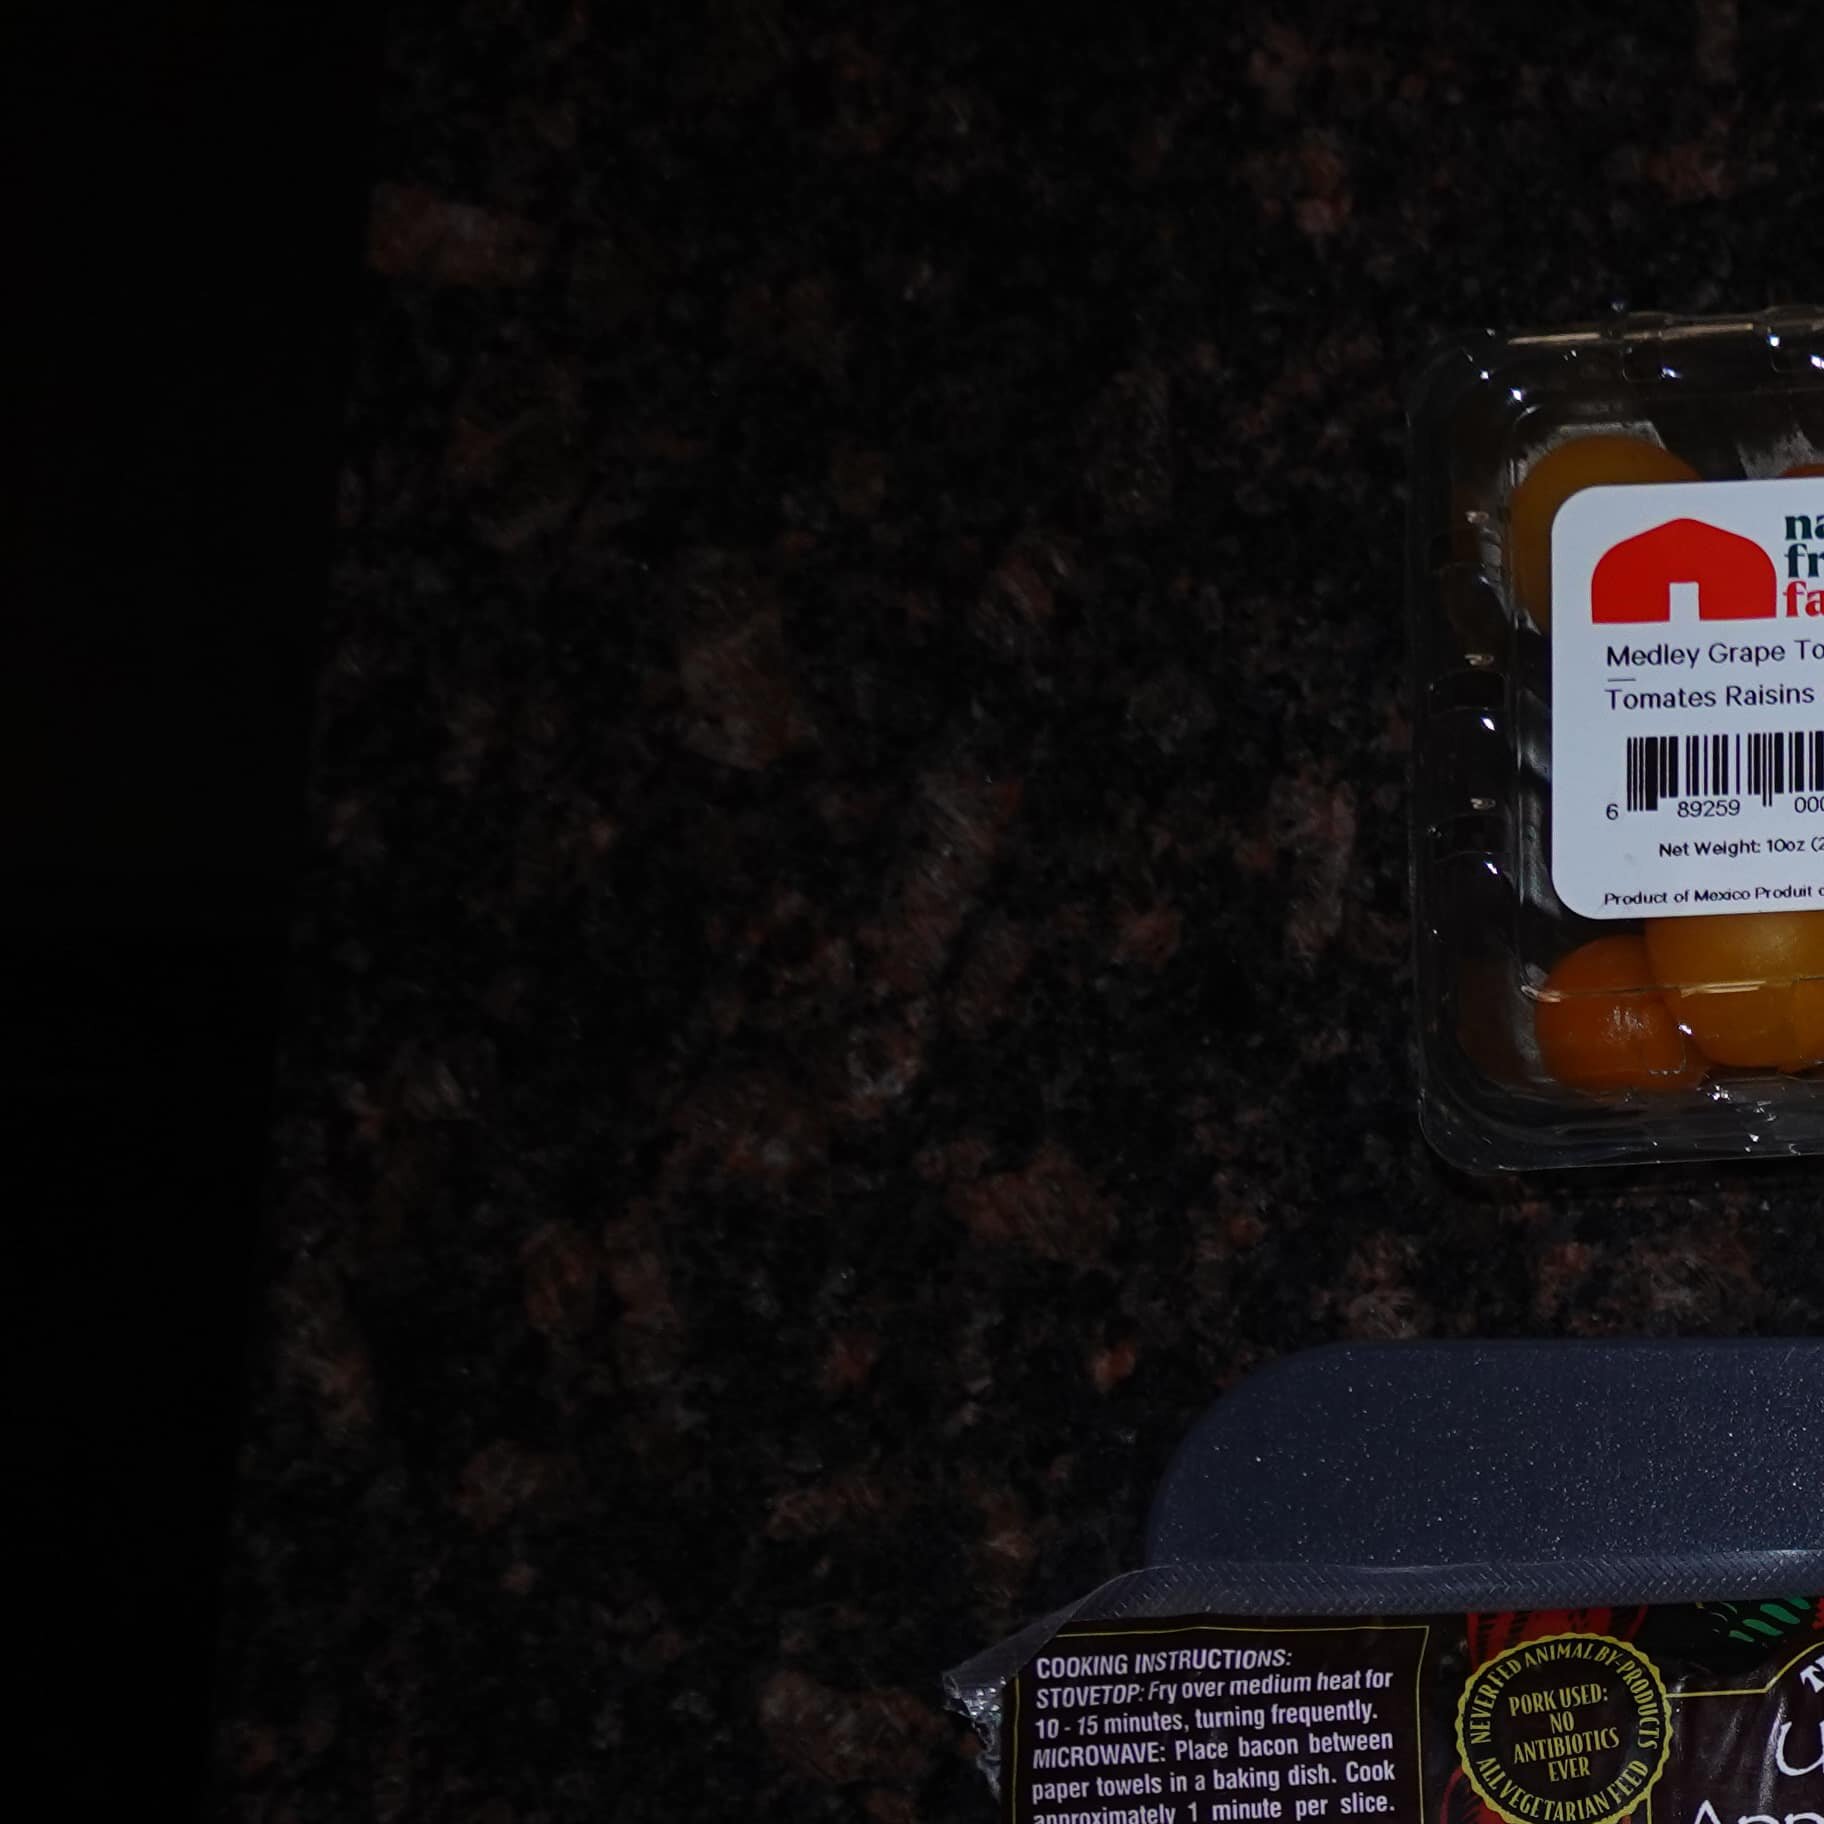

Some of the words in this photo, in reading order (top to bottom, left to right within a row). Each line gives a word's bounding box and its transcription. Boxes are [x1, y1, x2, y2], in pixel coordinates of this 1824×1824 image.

[1607, 644, 1700, 668] Medley
[1709, 642, 1785, 666] Grape
[1605, 687, 1716, 710] Tomates
[1726, 684, 1814, 706] Raisins
[1606, 803, 1619, 820] 6
[1677, 799, 1741, 817] 89259
[1659, 841, 1689, 857] Net
[1695, 839, 1761, 857] Weight:
[1767, 838, 1804, 853] 10oz
[1604, 891, 1667, 905] Product
[1674, 891, 1689, 903] of
[1695, 889, 1750, 902] Mexico
[1755, 885, 1812, 900] Produit
[1036, 1655, 1128, 1680] COOKING
[1135, 1649, 1292, 1674] INSTRUCTIONS:
[1036, 1683, 1144, 1709] STOVETOP:
[1148, 1681, 1178, 1703] Fry
[1181, 1679, 1224, 1699] over
[1228, 1673, 1312, 1697] medium
[1316, 1670, 1361, 1692] heat
[1365, 1669, 1394, 1689] for
[1508, 1691, 1556, 1717] PORK
[1560, 1683, 1608, 1705] USED:
[1550, 1711, 1575, 1734] NO
[1032, 1742, 1166, 1769] MICROWAVE:
[1175, 1739, 1228, 1761] Place
[1238, 1736, 1298, 1757] bacon
[1308, 1732, 1394, 1753] between
[1514, 1727, 1620, 1764] ANTIBIOTICS
[1548, 1757, 1590, 1782] EVER
[1188, 1801, 1198, 1823] 1
[1212, 1800, 1282, 1822] minute
[1295, 1798, 1328, 1821] per
[1340, 1792, 1395, 1816] slice.
